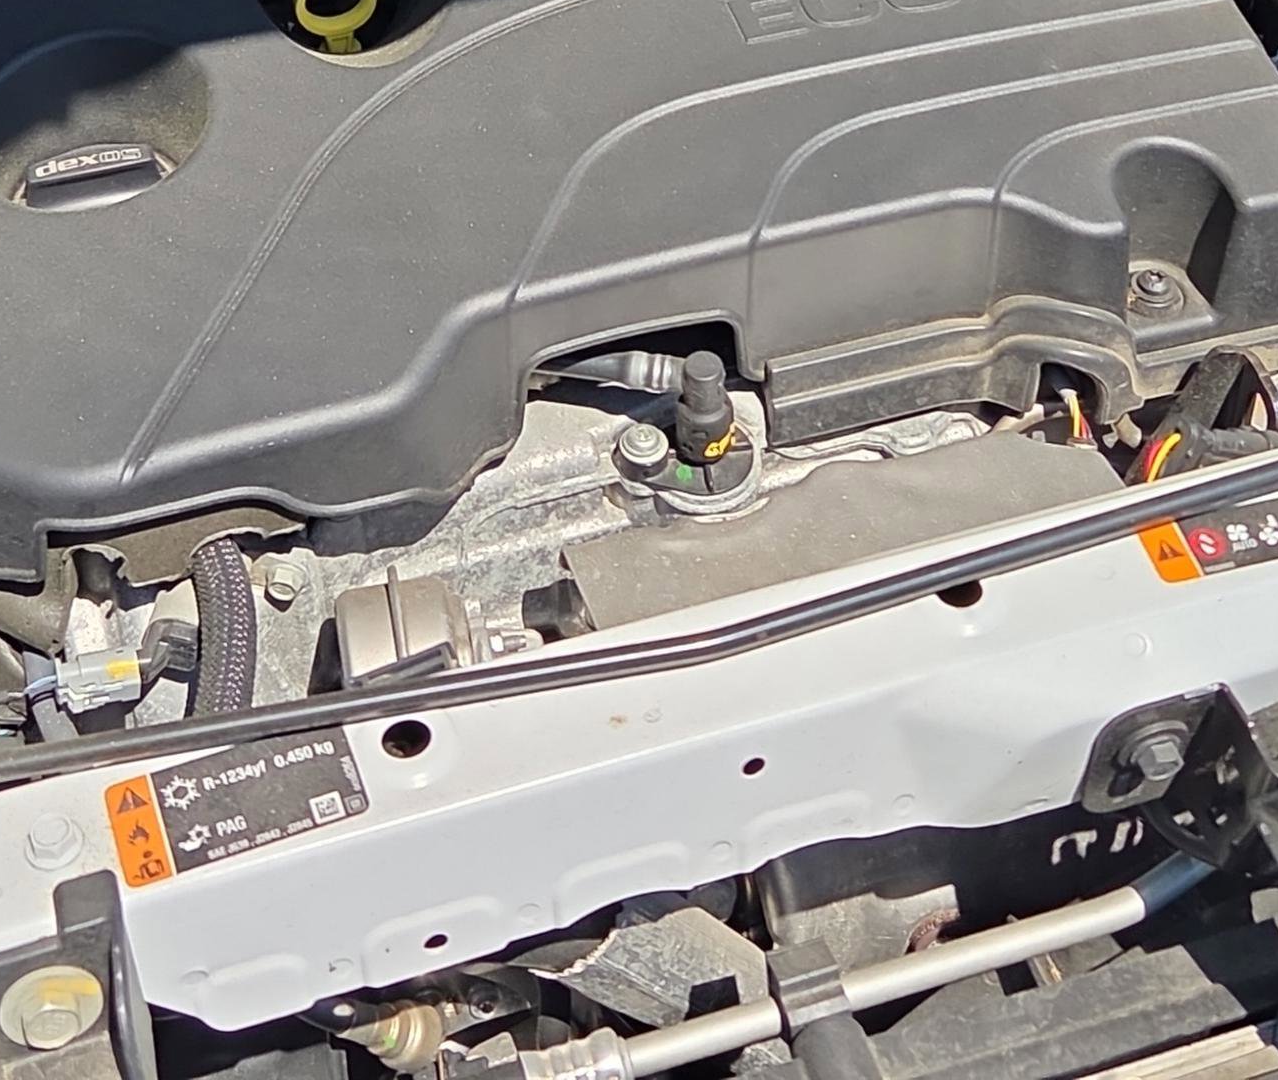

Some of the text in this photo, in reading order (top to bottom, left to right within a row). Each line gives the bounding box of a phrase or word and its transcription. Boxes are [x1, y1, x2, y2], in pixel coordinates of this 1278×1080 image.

[34, 148, 142, 178] dexos
[202, 741, 335, 791] R-1234yf 0.450 kg
[216, 815, 247, 837] PAG
